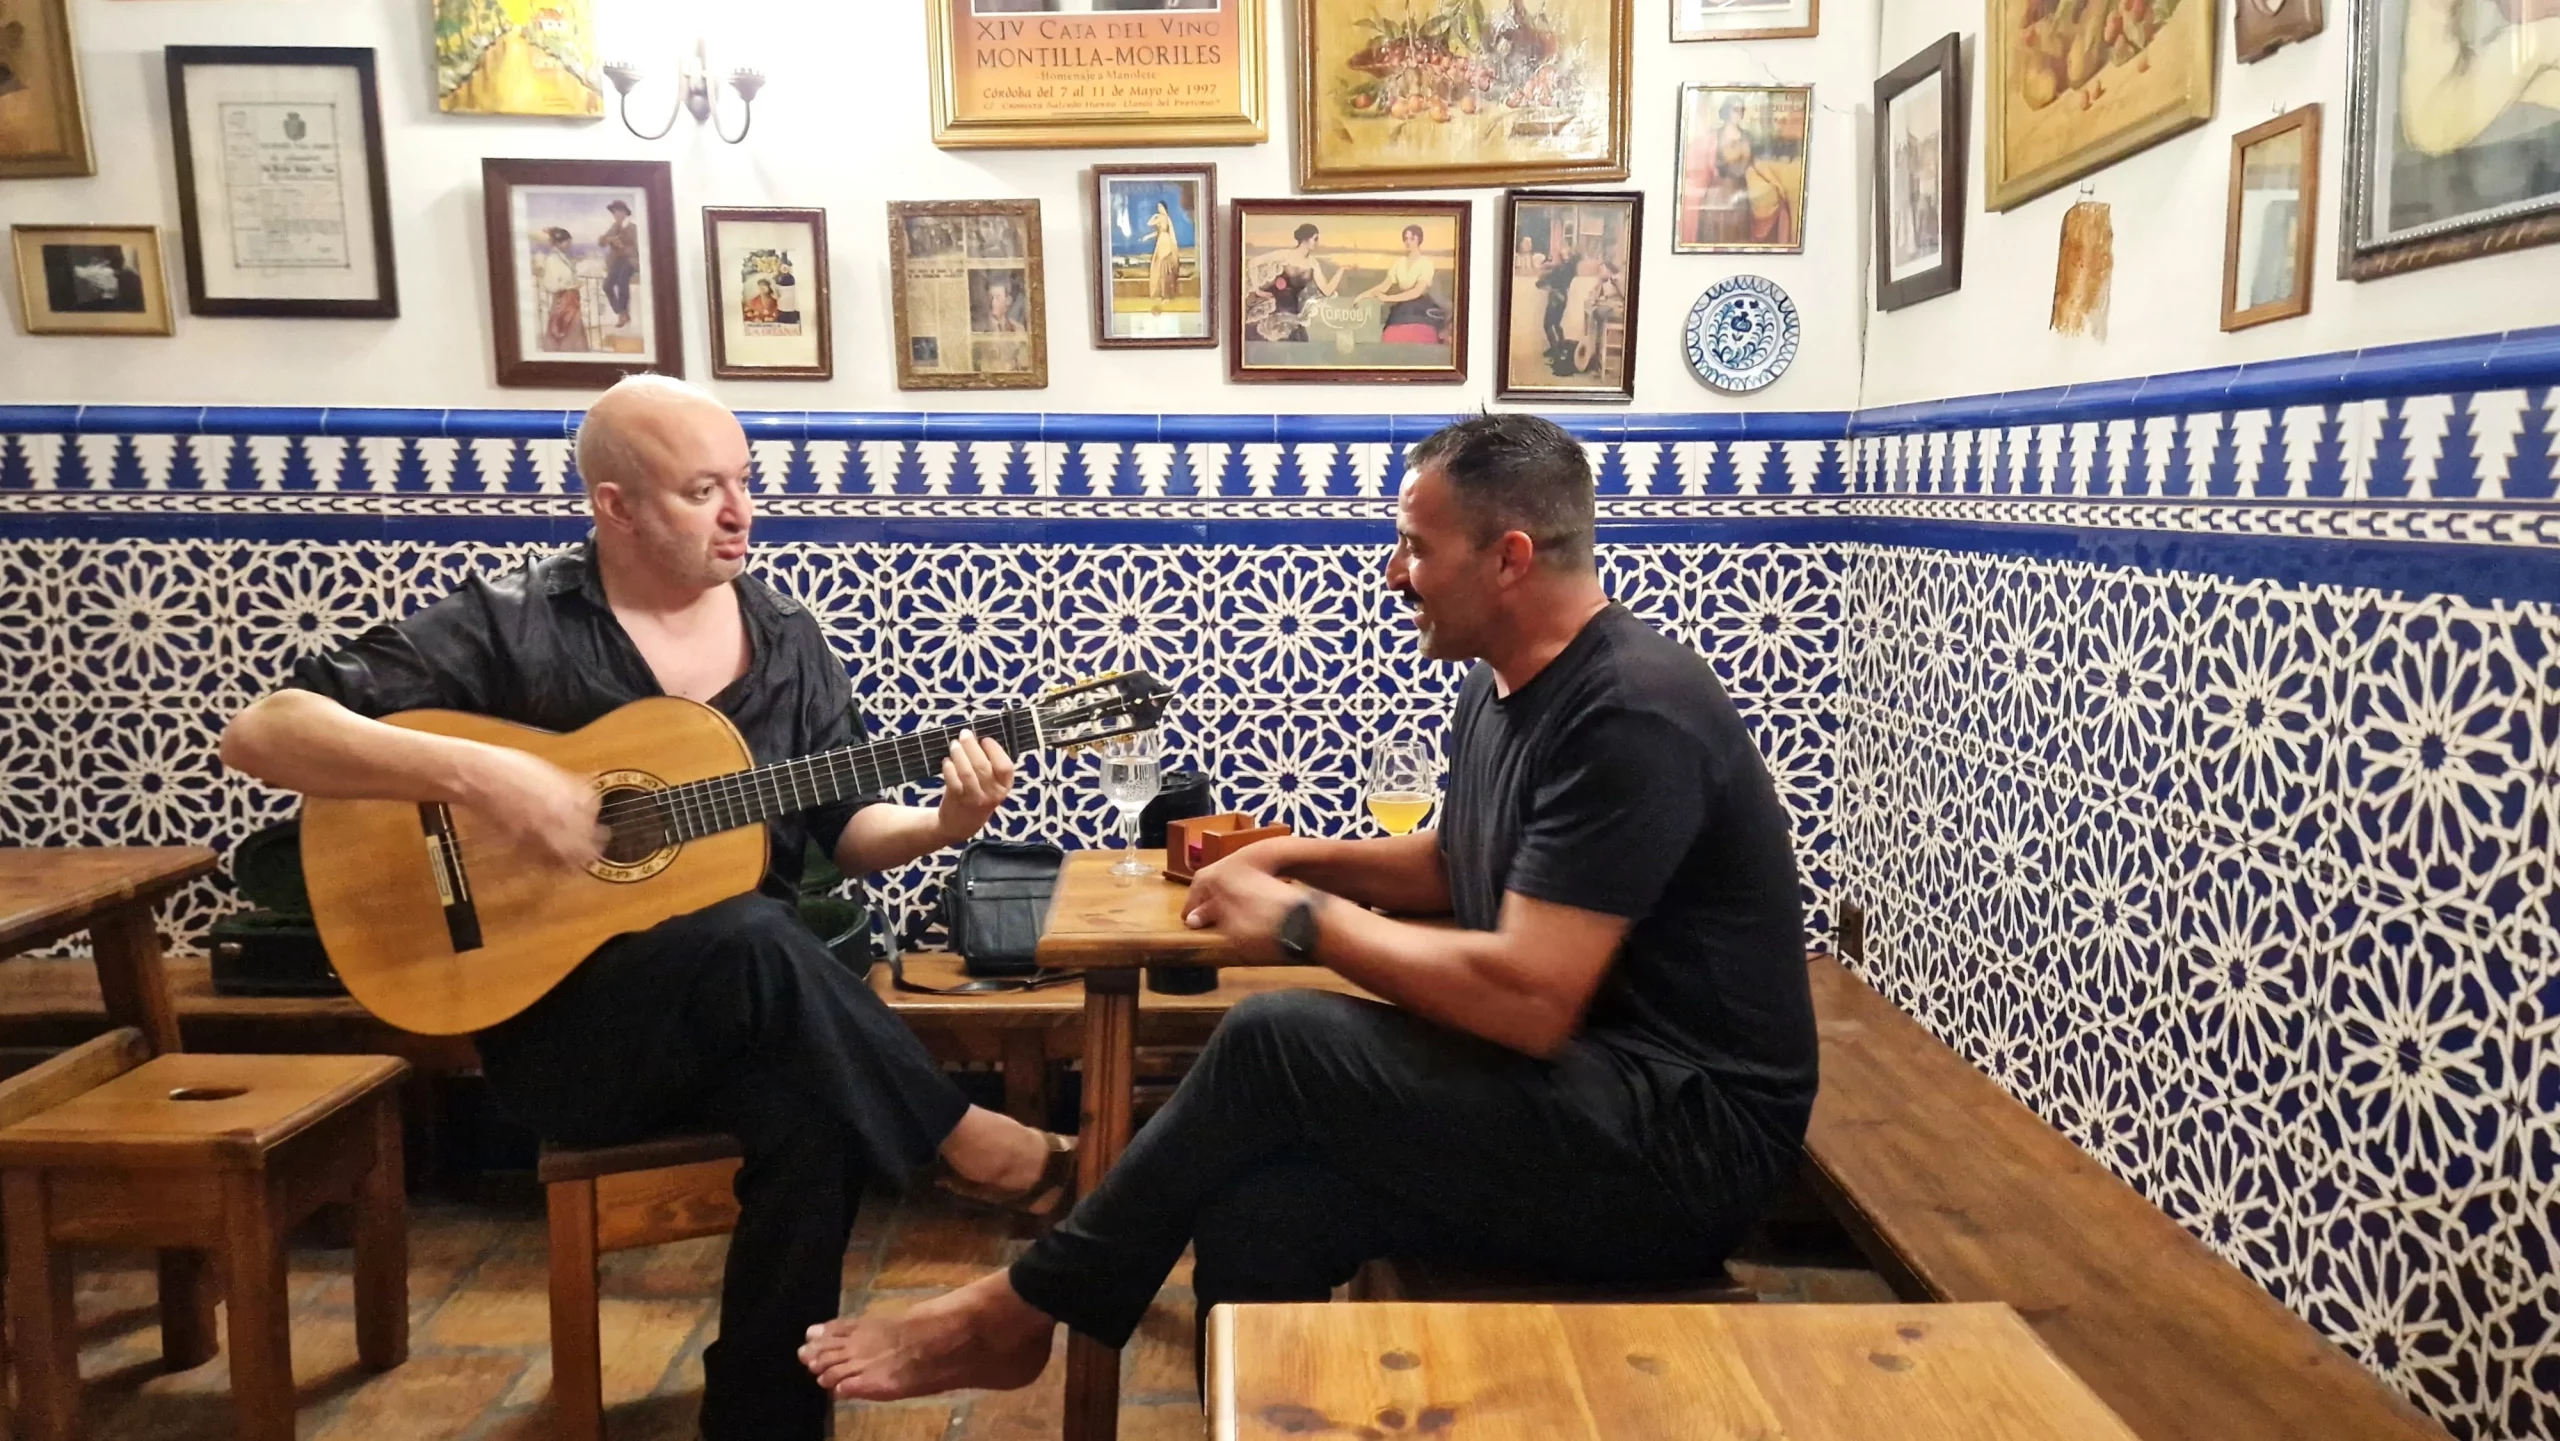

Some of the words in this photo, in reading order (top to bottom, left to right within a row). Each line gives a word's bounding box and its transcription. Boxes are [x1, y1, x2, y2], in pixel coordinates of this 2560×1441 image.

[977, 20, 1024, 40] XIV
[977, 44, 1221, 68] MONTILLA-MORILES
[1037, 86, 1054, 98] del
[1061, 86, 1068, 97] 7
[1073, 85, 1084, 97] al
[1092, 86, 1105, 97] 11
[1111, 84, 1124, 97] de
[1129, 85, 1163, 99] Mayo
[1167, 83, 1180, 96] de
[1187, 83, 1217, 96] 1997
